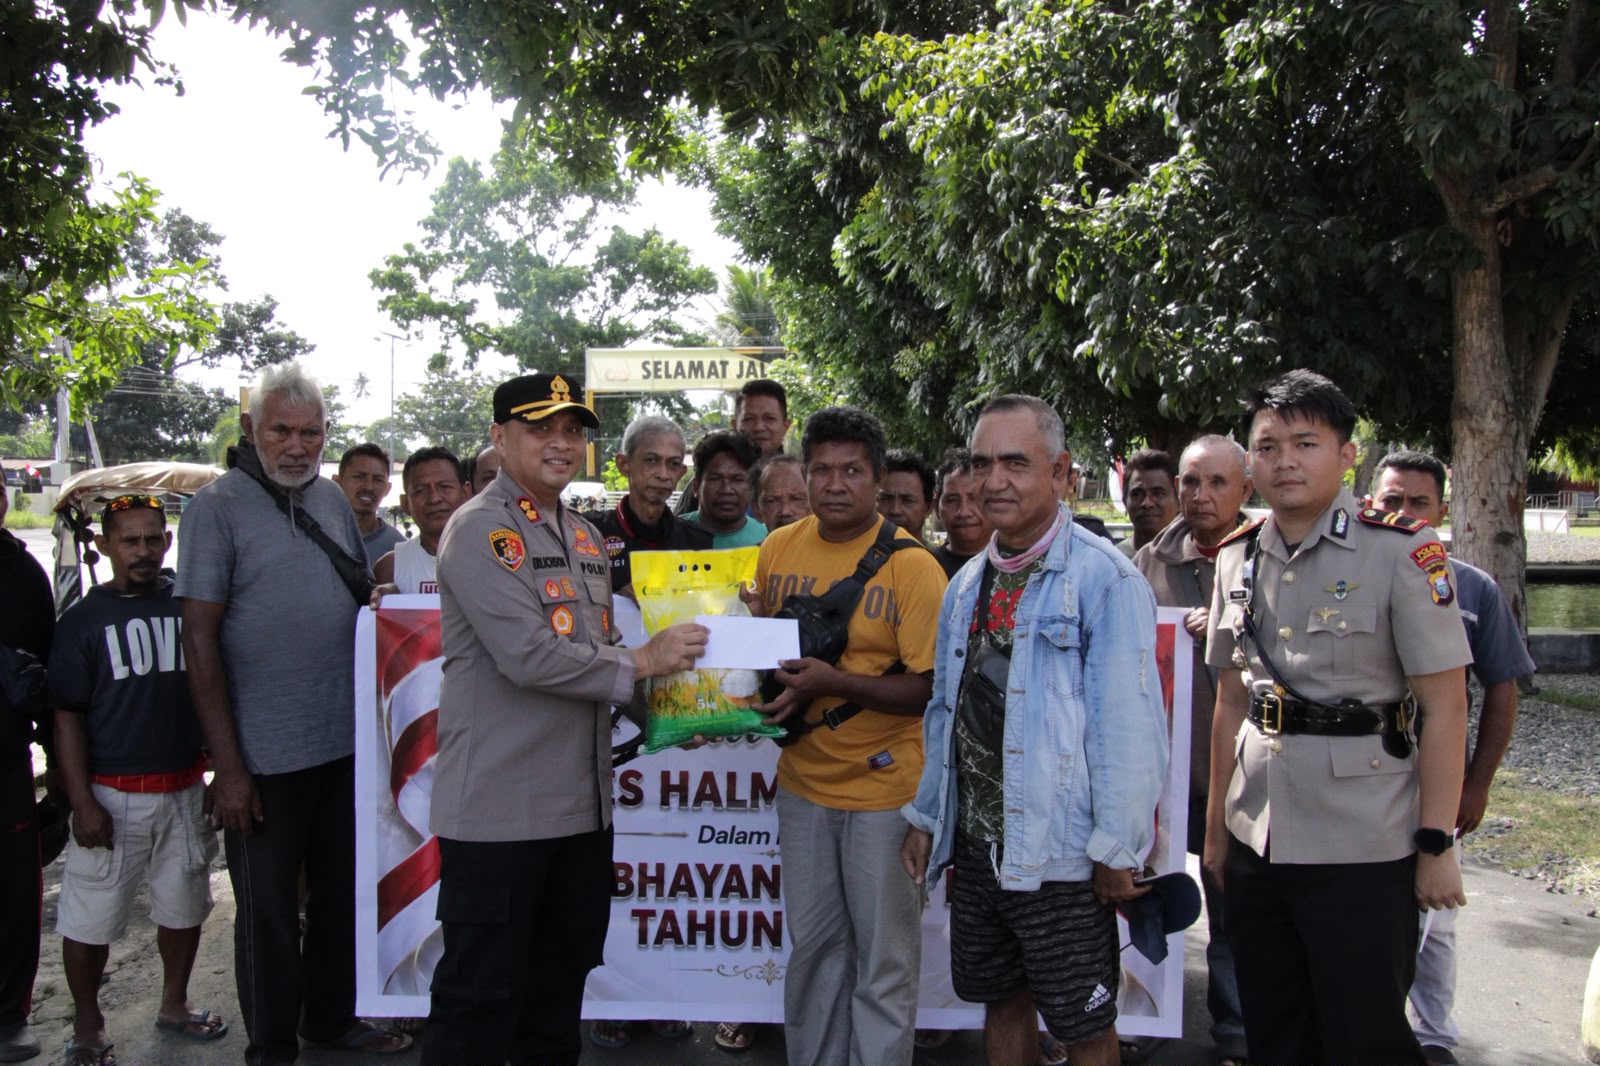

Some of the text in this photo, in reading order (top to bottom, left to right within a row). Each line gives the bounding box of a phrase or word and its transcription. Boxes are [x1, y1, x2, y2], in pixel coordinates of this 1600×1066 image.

[641, 360, 730, 380] SELAMAT
[697, 824, 771, 845] Dalam
[631, 908, 783, 949] TAHUN
[1084, 992, 1111, 1012] adidas
